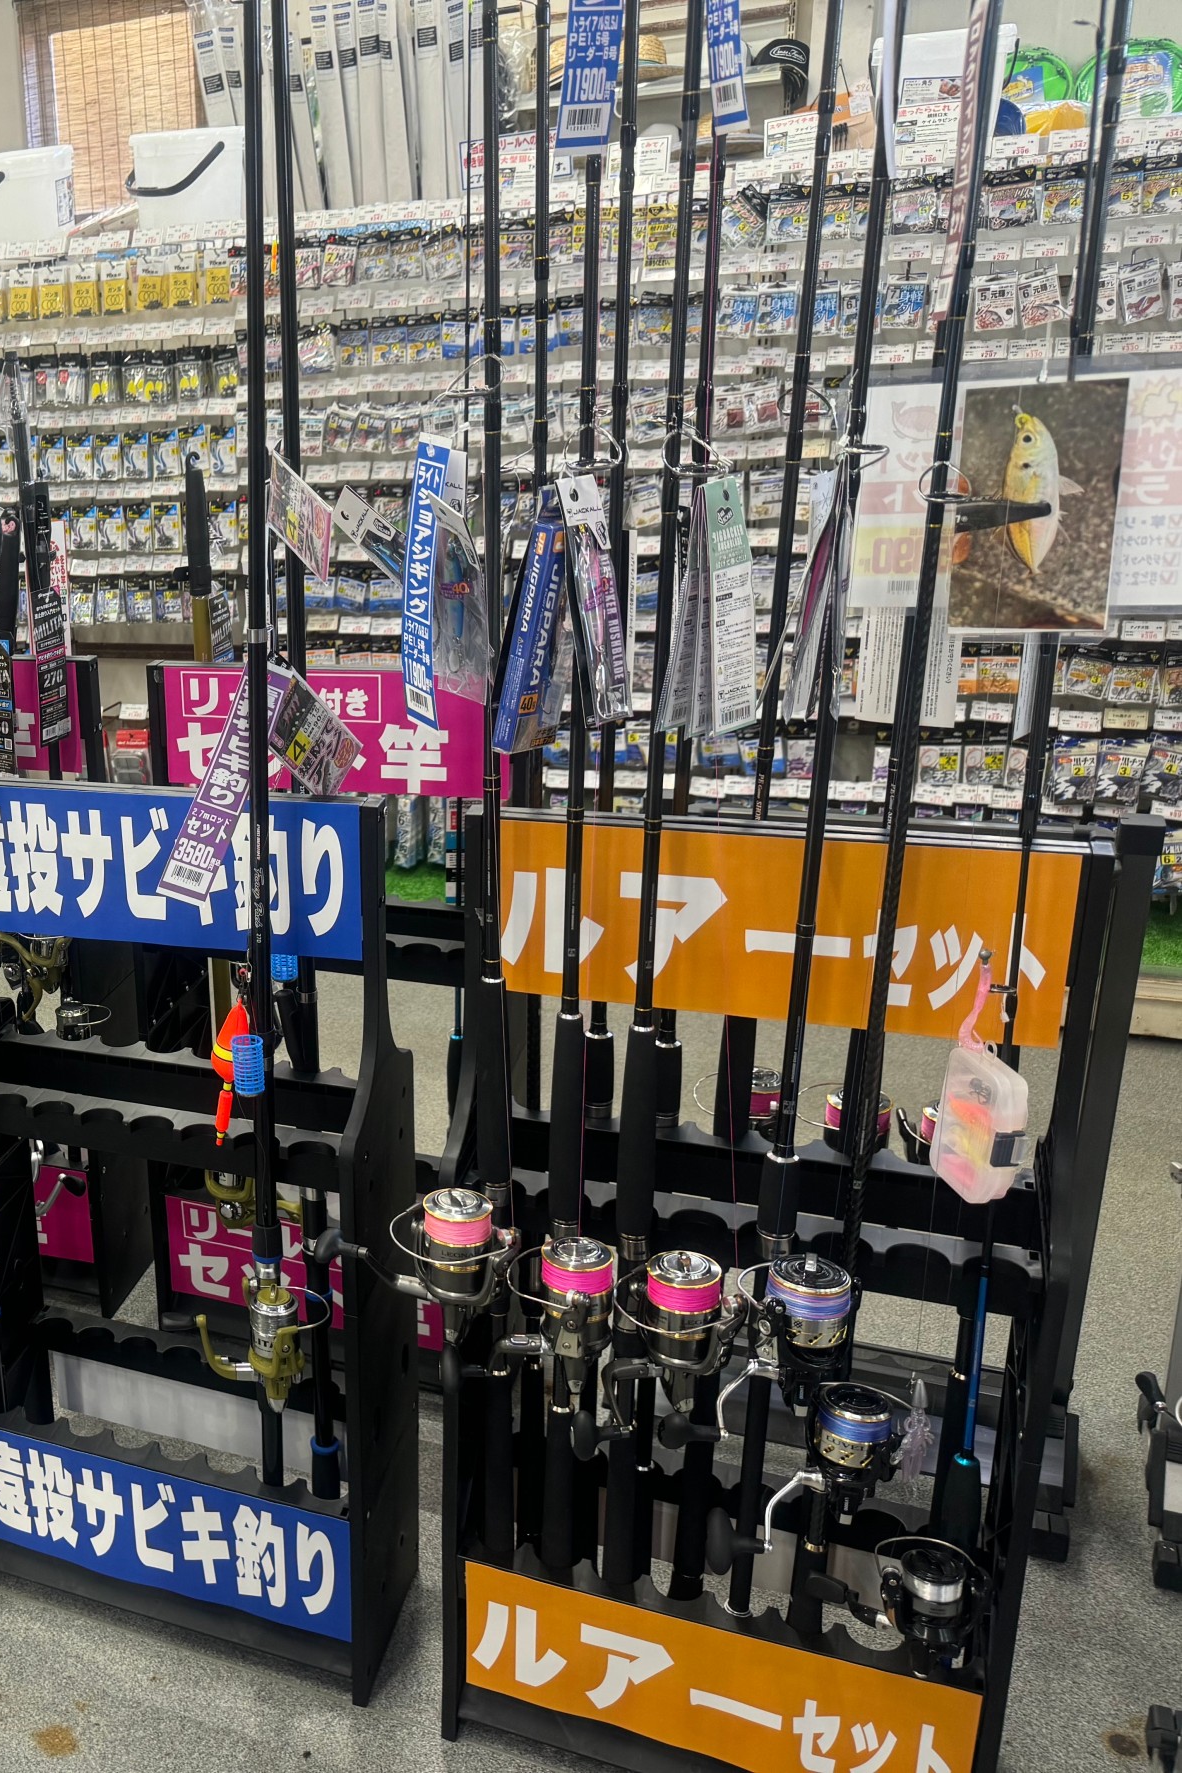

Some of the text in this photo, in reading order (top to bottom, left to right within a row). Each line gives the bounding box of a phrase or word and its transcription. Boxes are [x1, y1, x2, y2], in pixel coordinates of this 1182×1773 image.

[569, 32, 611, 47] PE1.5号
[709, 41, 736, 81] 11900
[566, 67, 607, 102] 11900
[418, 464, 441, 485] ライト
[409, 489, 433, 616] ショアジギング
[521, 555, 542, 633] JIGPARA
[529, 563, 559, 687] JIGPARA
[43, 668, 63, 689] 270
[404, 656, 427, 692] 11900
[189, 678, 369, 717] リ付き
[187, 815, 232, 842] セット
[174, 837, 214, 869] 3580
[501, 867, 1046, 1011] ルアーセット
[472, 1600, 947, 1773] ルアーセット
